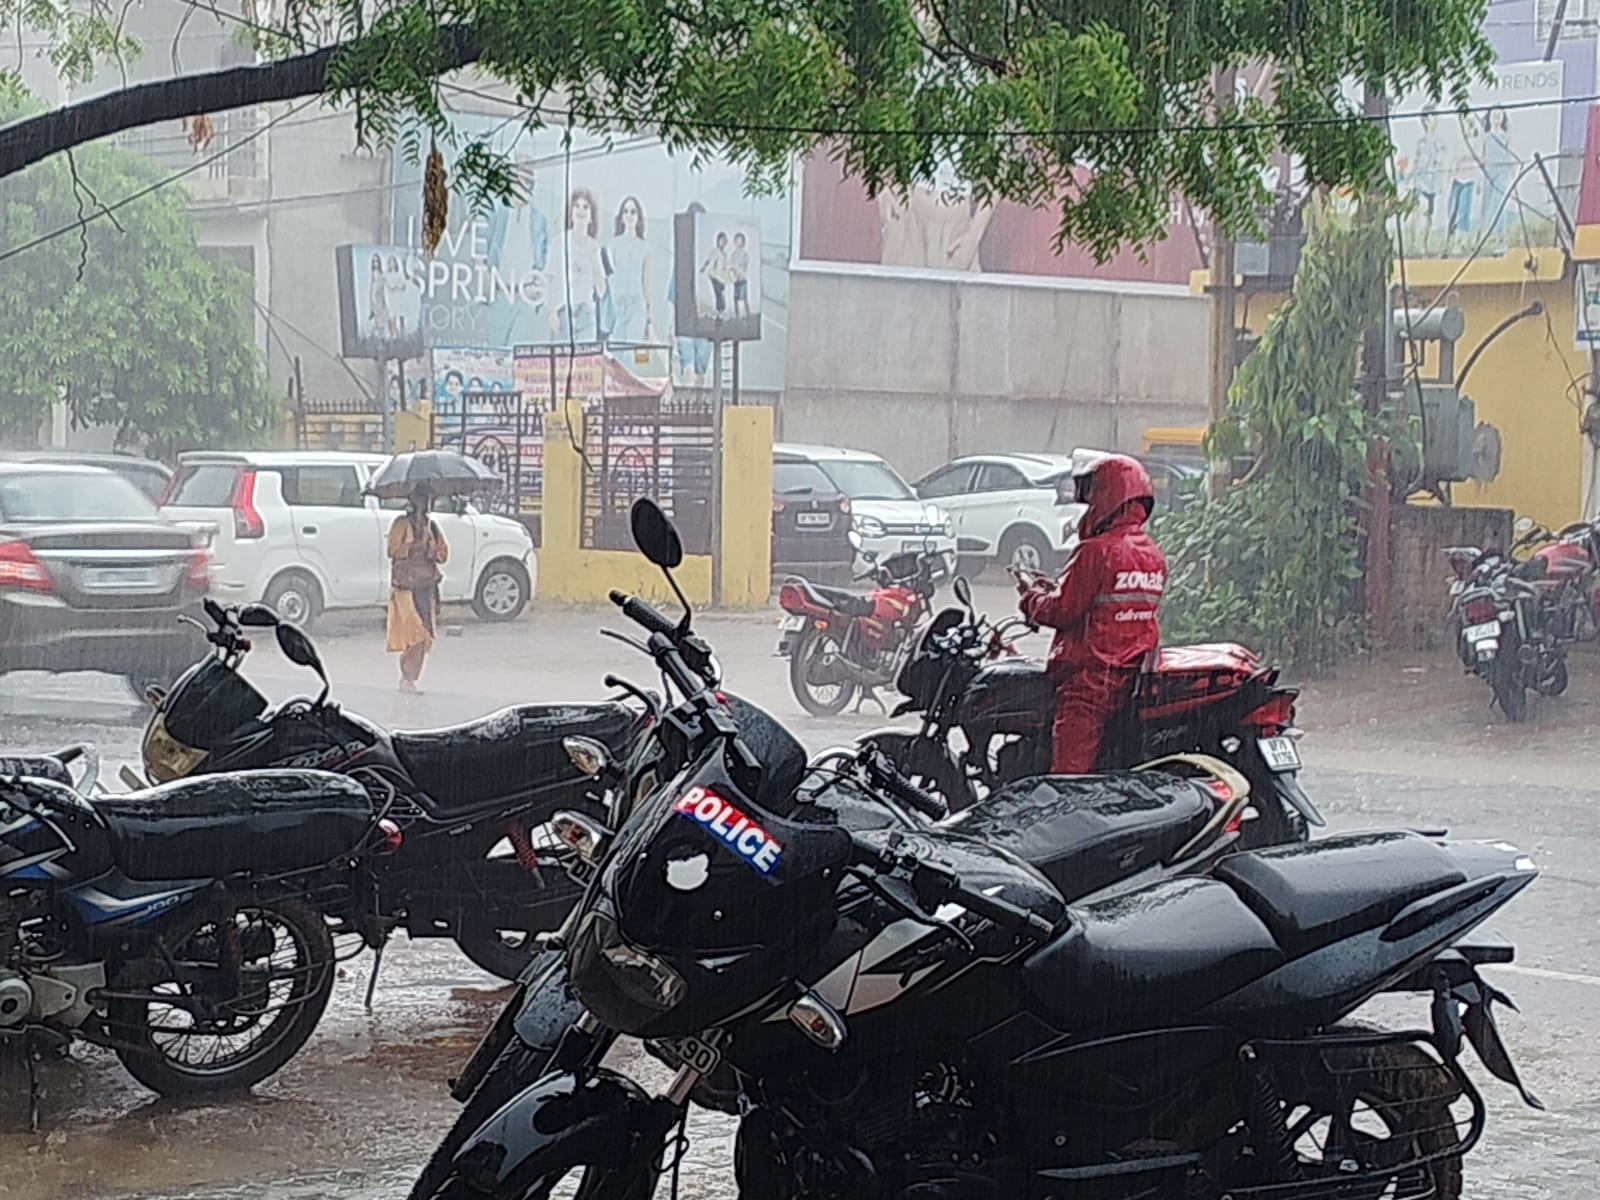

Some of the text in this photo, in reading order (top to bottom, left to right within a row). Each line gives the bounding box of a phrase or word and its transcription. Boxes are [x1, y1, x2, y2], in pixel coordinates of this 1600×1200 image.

[1498, 72, 1559, 89] RENDS
[407, 215, 490, 259] LVE
[407, 259, 547, 306] SPRING
[421, 303, 483, 331] TORY
[677, 786, 782, 873] POLICE
